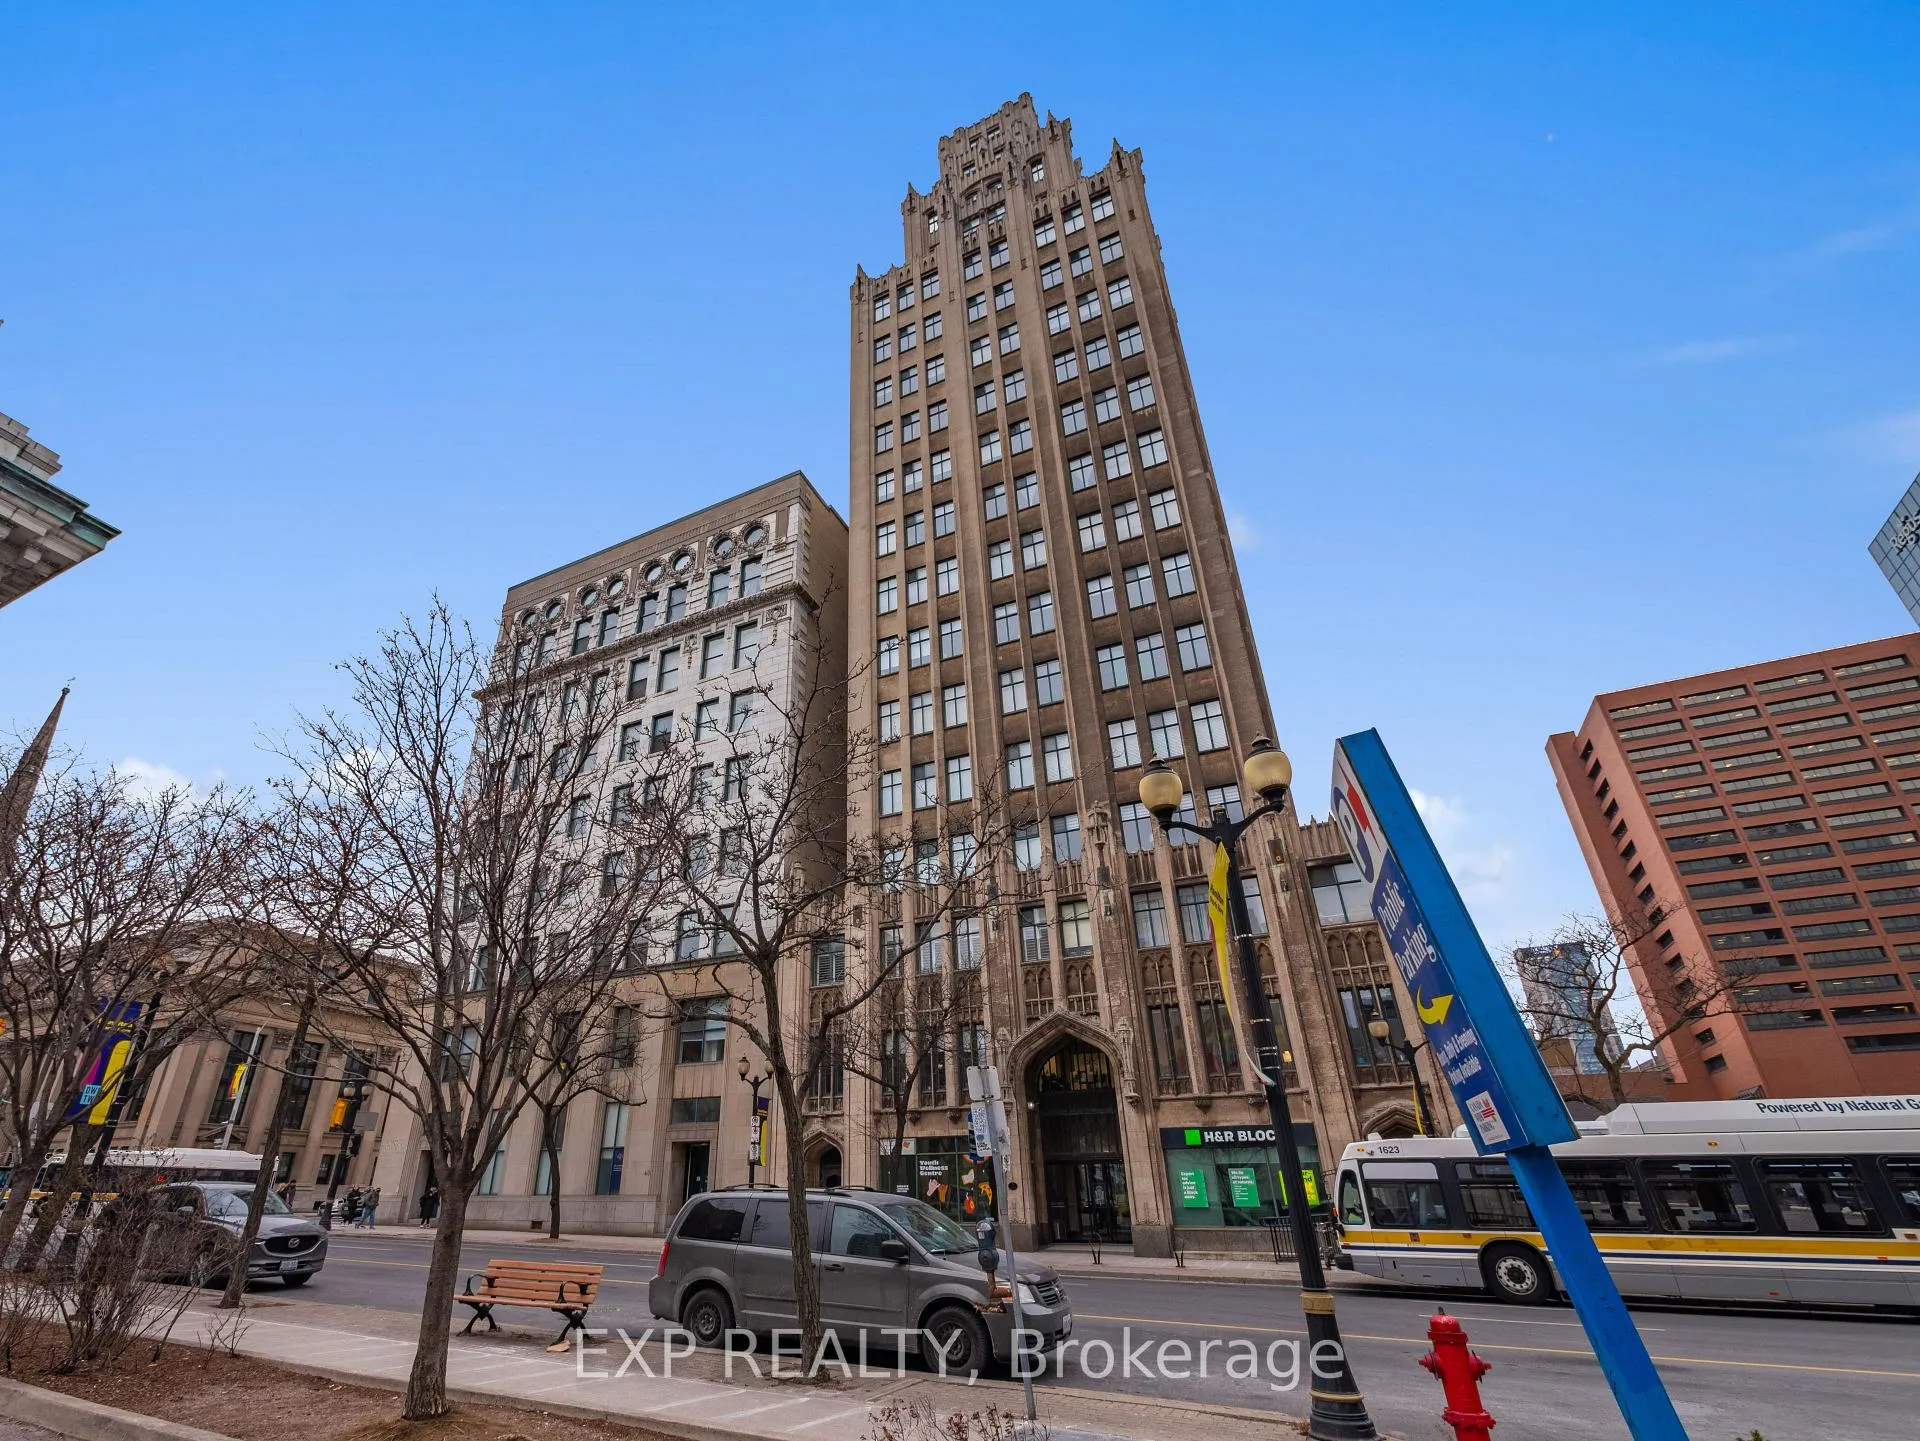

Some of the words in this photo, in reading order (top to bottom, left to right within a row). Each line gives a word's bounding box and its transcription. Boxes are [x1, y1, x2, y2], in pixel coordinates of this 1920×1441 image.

[1377, 879, 1406, 940] Public
[1394, 922, 1437, 987] Parking
[1755, 1101, 1824, 1114] Powered
[1823, 1100, 1845, 1114] by
[1845, 1099, 1907, 1111] Natural
[1905, 1097, 1920, 1110] G
[1203, 1130, 1235, 1143] H&R
[1236, 1129, 1276, 1142] BLOC
[1378, 1145, 1400, 1154] 1623
